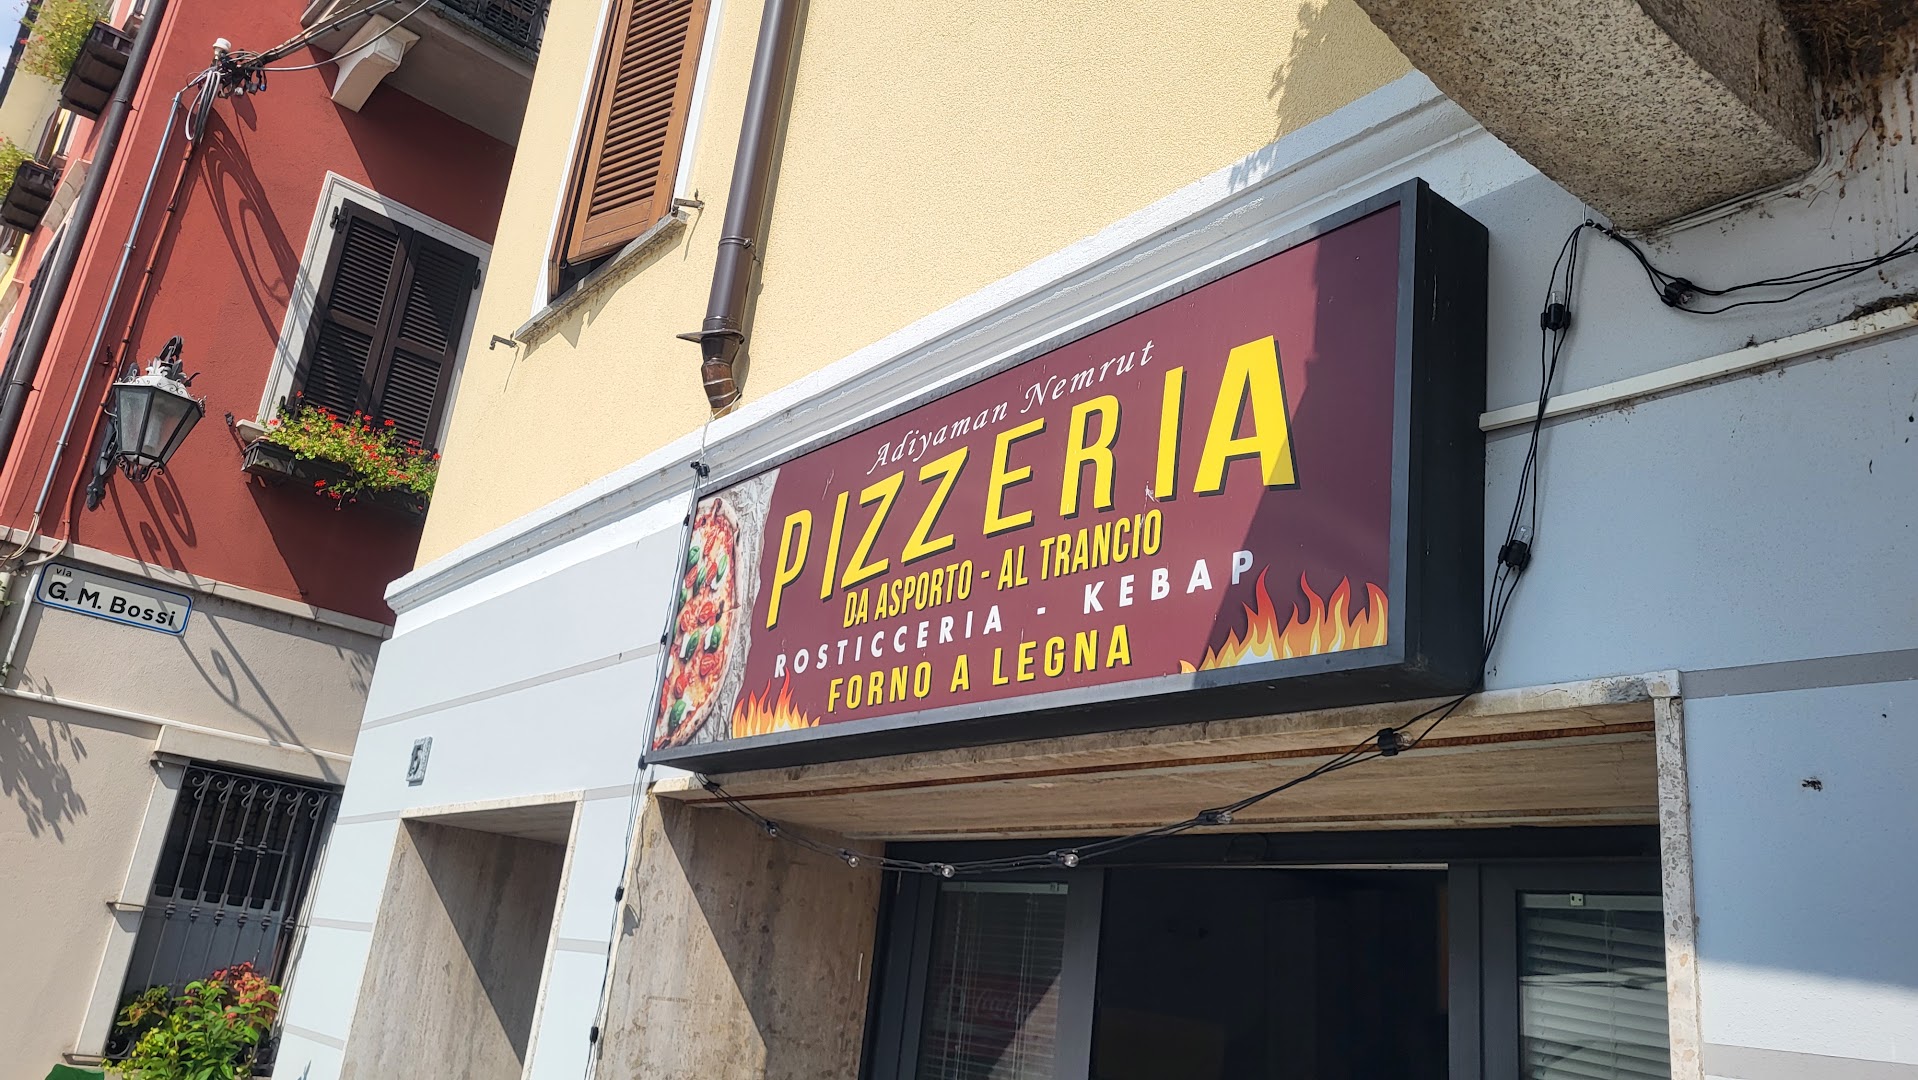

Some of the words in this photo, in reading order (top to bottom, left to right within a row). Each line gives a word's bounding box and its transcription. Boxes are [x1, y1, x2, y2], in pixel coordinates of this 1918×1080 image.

[866, 401, 1008, 475] Adiyaman
[1020, 339, 1155, 414] Nemrut
[766, 335, 1298, 630] PIZZERIA
[48, 581, 69, 602] G.
[77, 587, 102, 610] M.
[109, 595, 176, 627] Bossi
[56, 566, 73, 577] via
[774, 604, 1003, 679] ROSTICCERIA
[1036, 606, 1046, 615] -
[1083, 550, 1254, 615] KEBAP
[843, 587, 869, 629] DA
[874, 559, 974, 621] ASPORTO
[981, 569, 991, 580] -
[997, 545, 1029, 592] AL
[1039, 509, 1163, 580] TRANCIO
[828, 661, 932, 713] FORNO
[950, 654, 971, 693] A
[992, 624, 1133, 686] LEGNA
